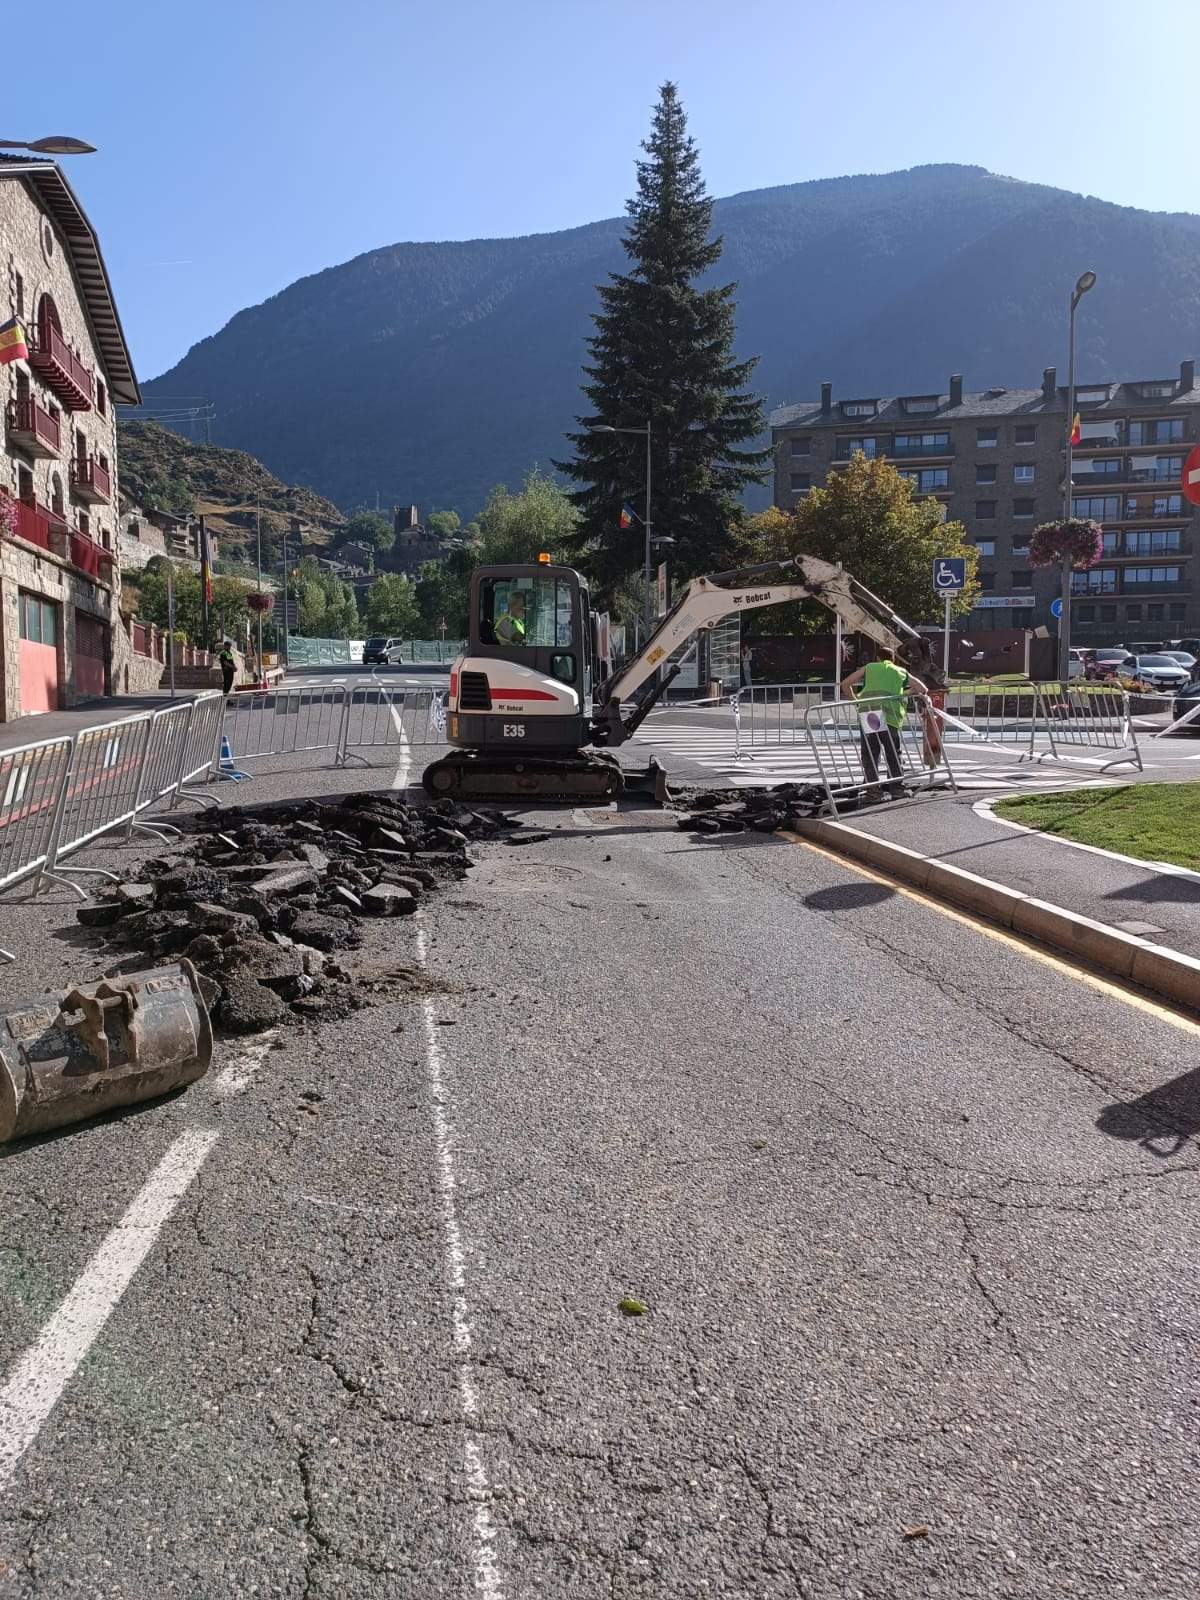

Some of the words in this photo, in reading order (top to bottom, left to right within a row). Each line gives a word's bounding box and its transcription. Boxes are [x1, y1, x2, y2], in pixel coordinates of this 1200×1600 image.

[745, 591, 771, 604] Bobcat
[506, 704, 524, 712] Bobcat
[503, 724, 526, 738] E35
